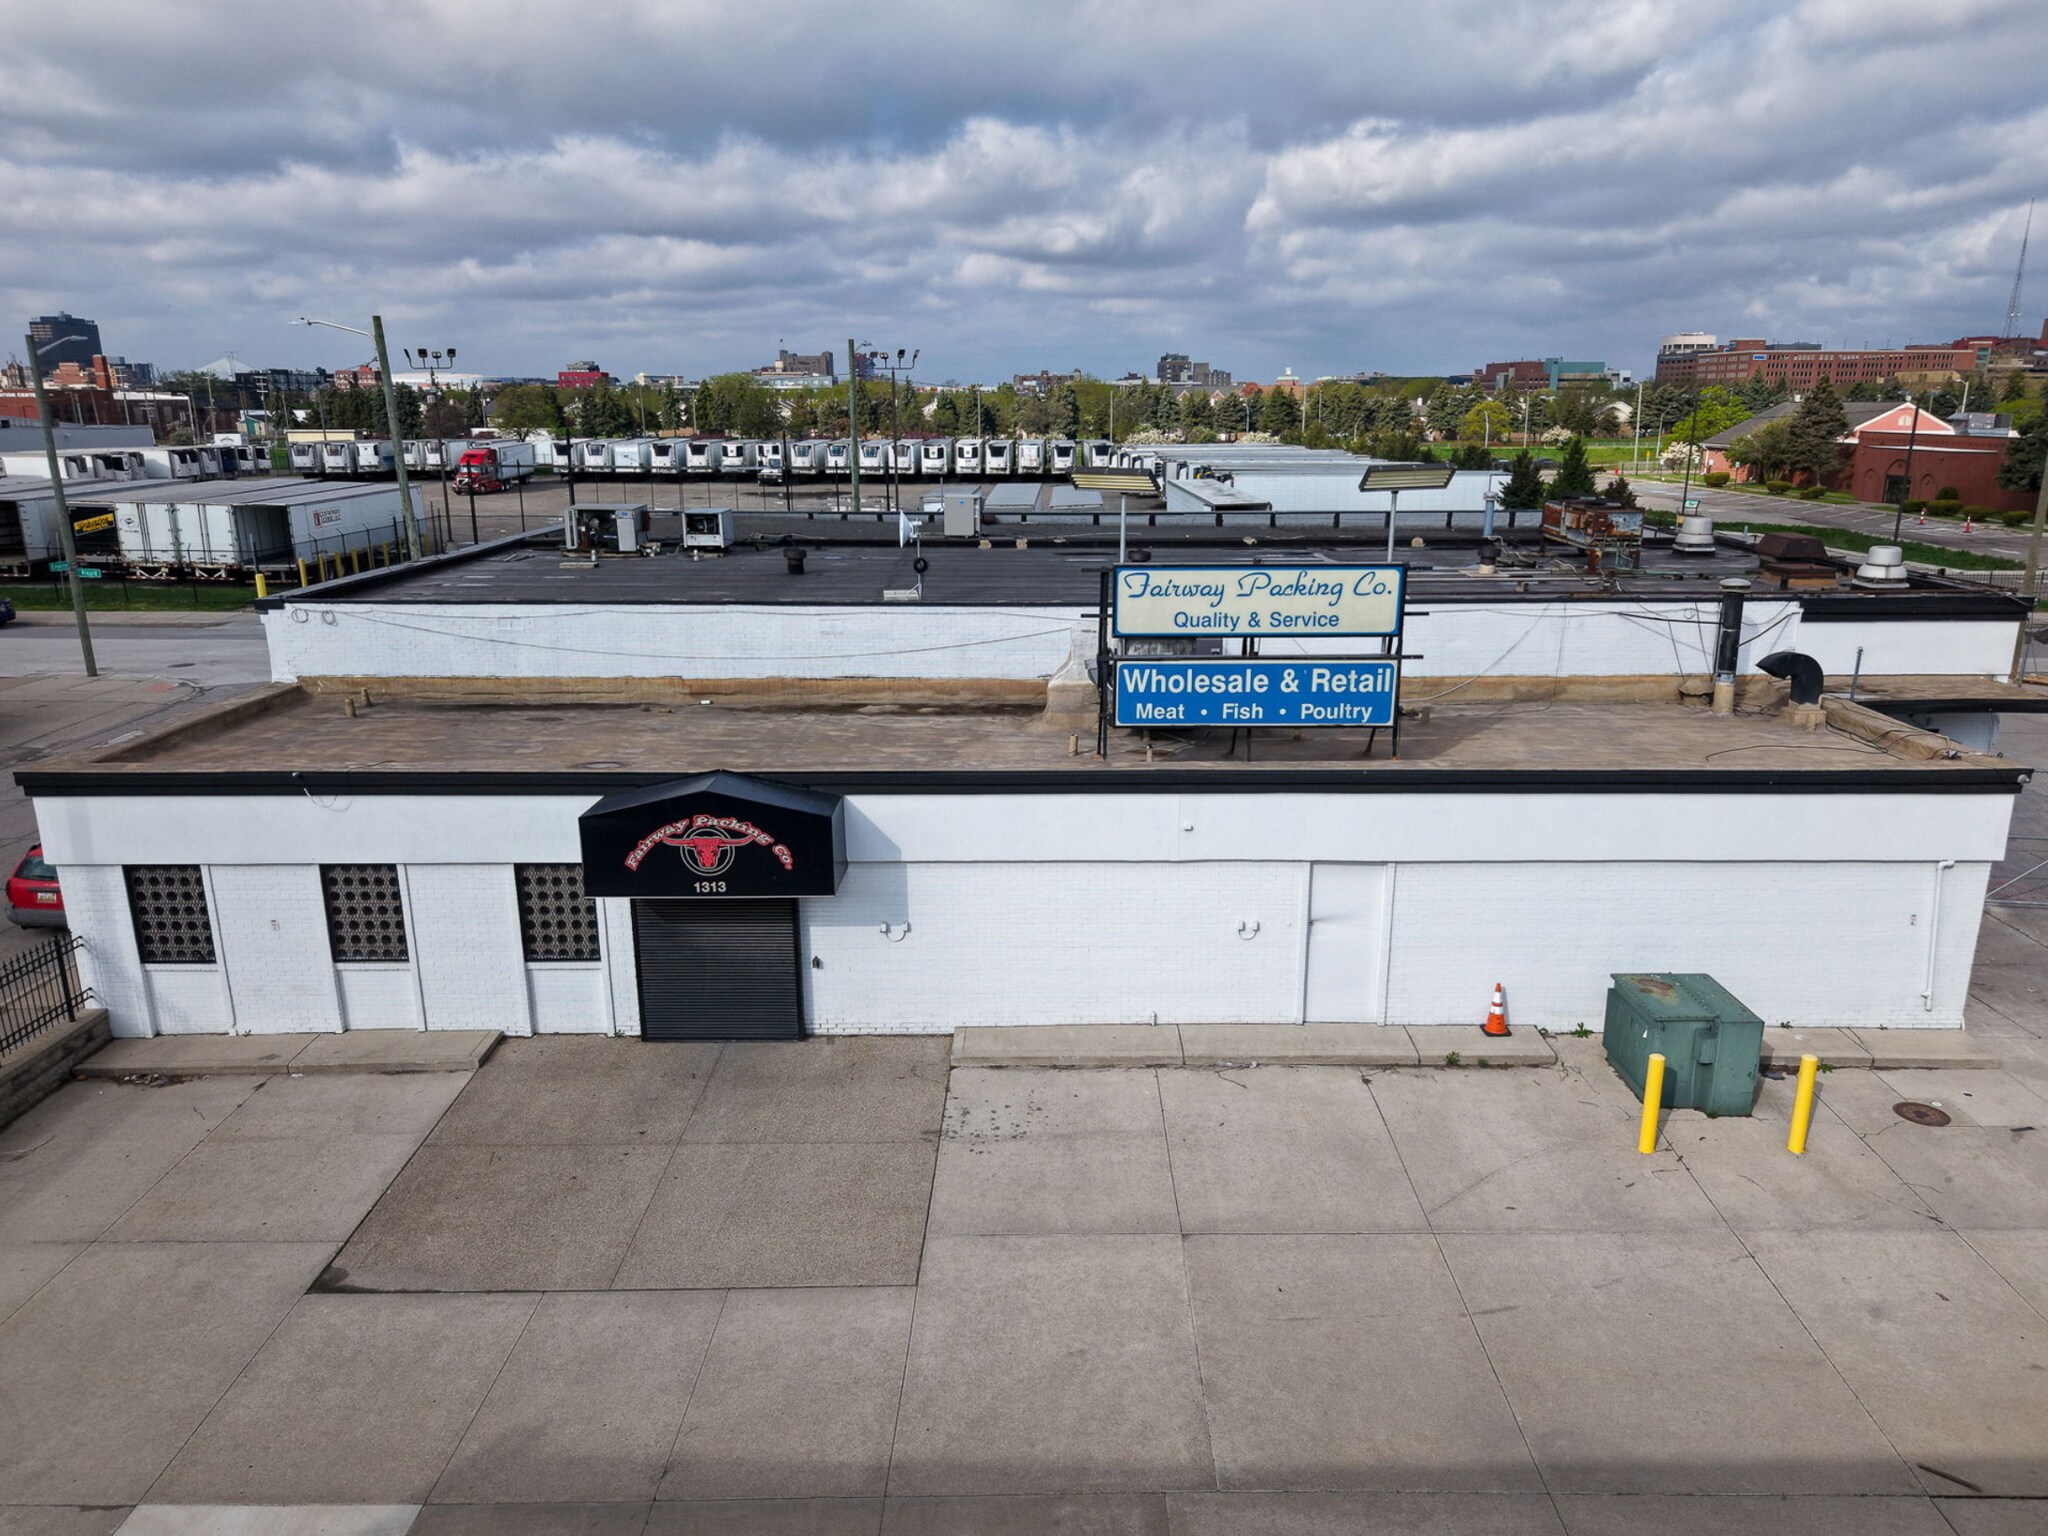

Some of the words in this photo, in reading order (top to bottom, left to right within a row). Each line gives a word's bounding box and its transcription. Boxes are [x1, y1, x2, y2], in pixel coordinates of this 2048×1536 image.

[1124, 571, 1225, 607] Fairway
[1236, 570, 1343, 607] Packing
[1353, 571, 1392, 596] Co.
[1173, 611, 1240, 632] Quality
[1248, 612, 1261, 628] &
[1269, 611, 1339, 628] Service
[1123, 668, 1270, 693] Wholesale
[1280, 668, 1299, 693] &
[1311, 668, 1391, 693] Retail
[1135, 703, 1185, 720] Meat
[1222, 703, 1263, 720] Fish
[1300, 703, 1373, 723] Poultry
[624, 818, 690, 871] Fairway
[692, 814, 774, 846] Packing
[693, 881, 727, 893] 1313
